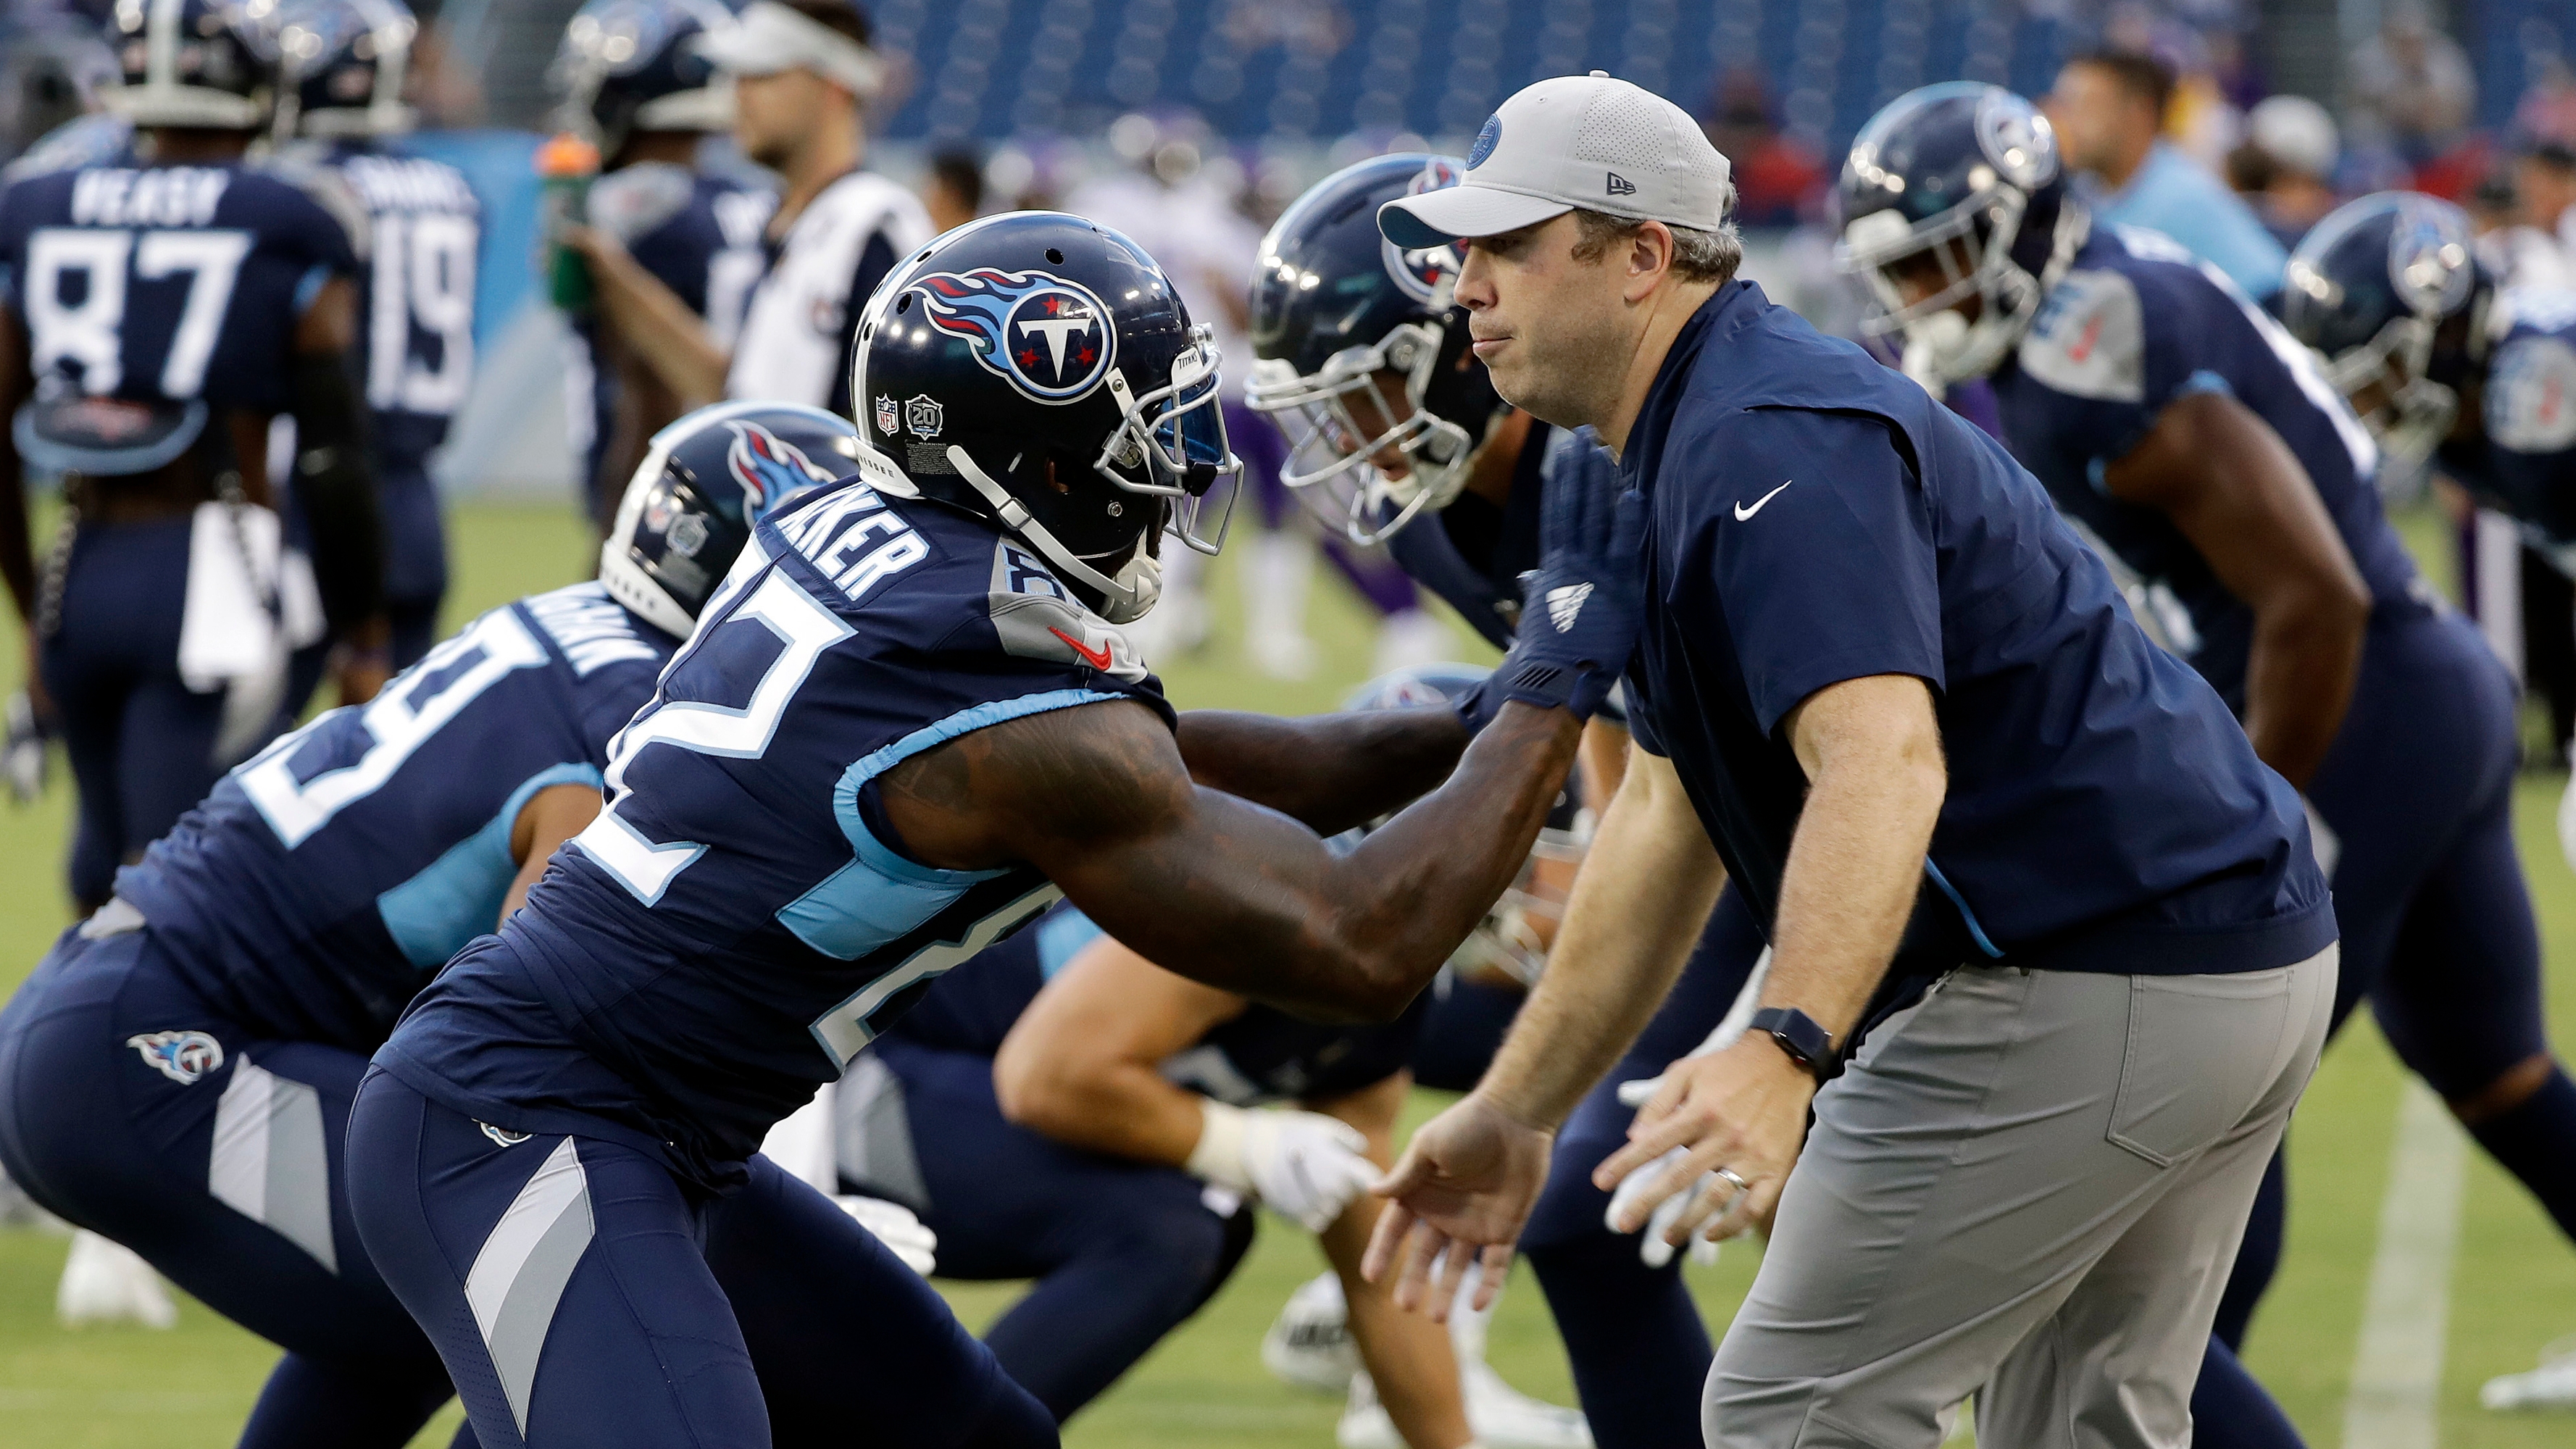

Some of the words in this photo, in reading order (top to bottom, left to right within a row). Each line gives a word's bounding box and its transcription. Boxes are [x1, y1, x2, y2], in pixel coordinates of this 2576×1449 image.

[28, 228, 254, 400] 87
[368, 214, 479, 414] 19
[1177, 351, 1198, 369] TITANS
[879, 412, 896, 429] NFL
[913, 406, 936, 426] 20
[230, 602, 554, 850] 9
[571, 534, 859, 909] 2
